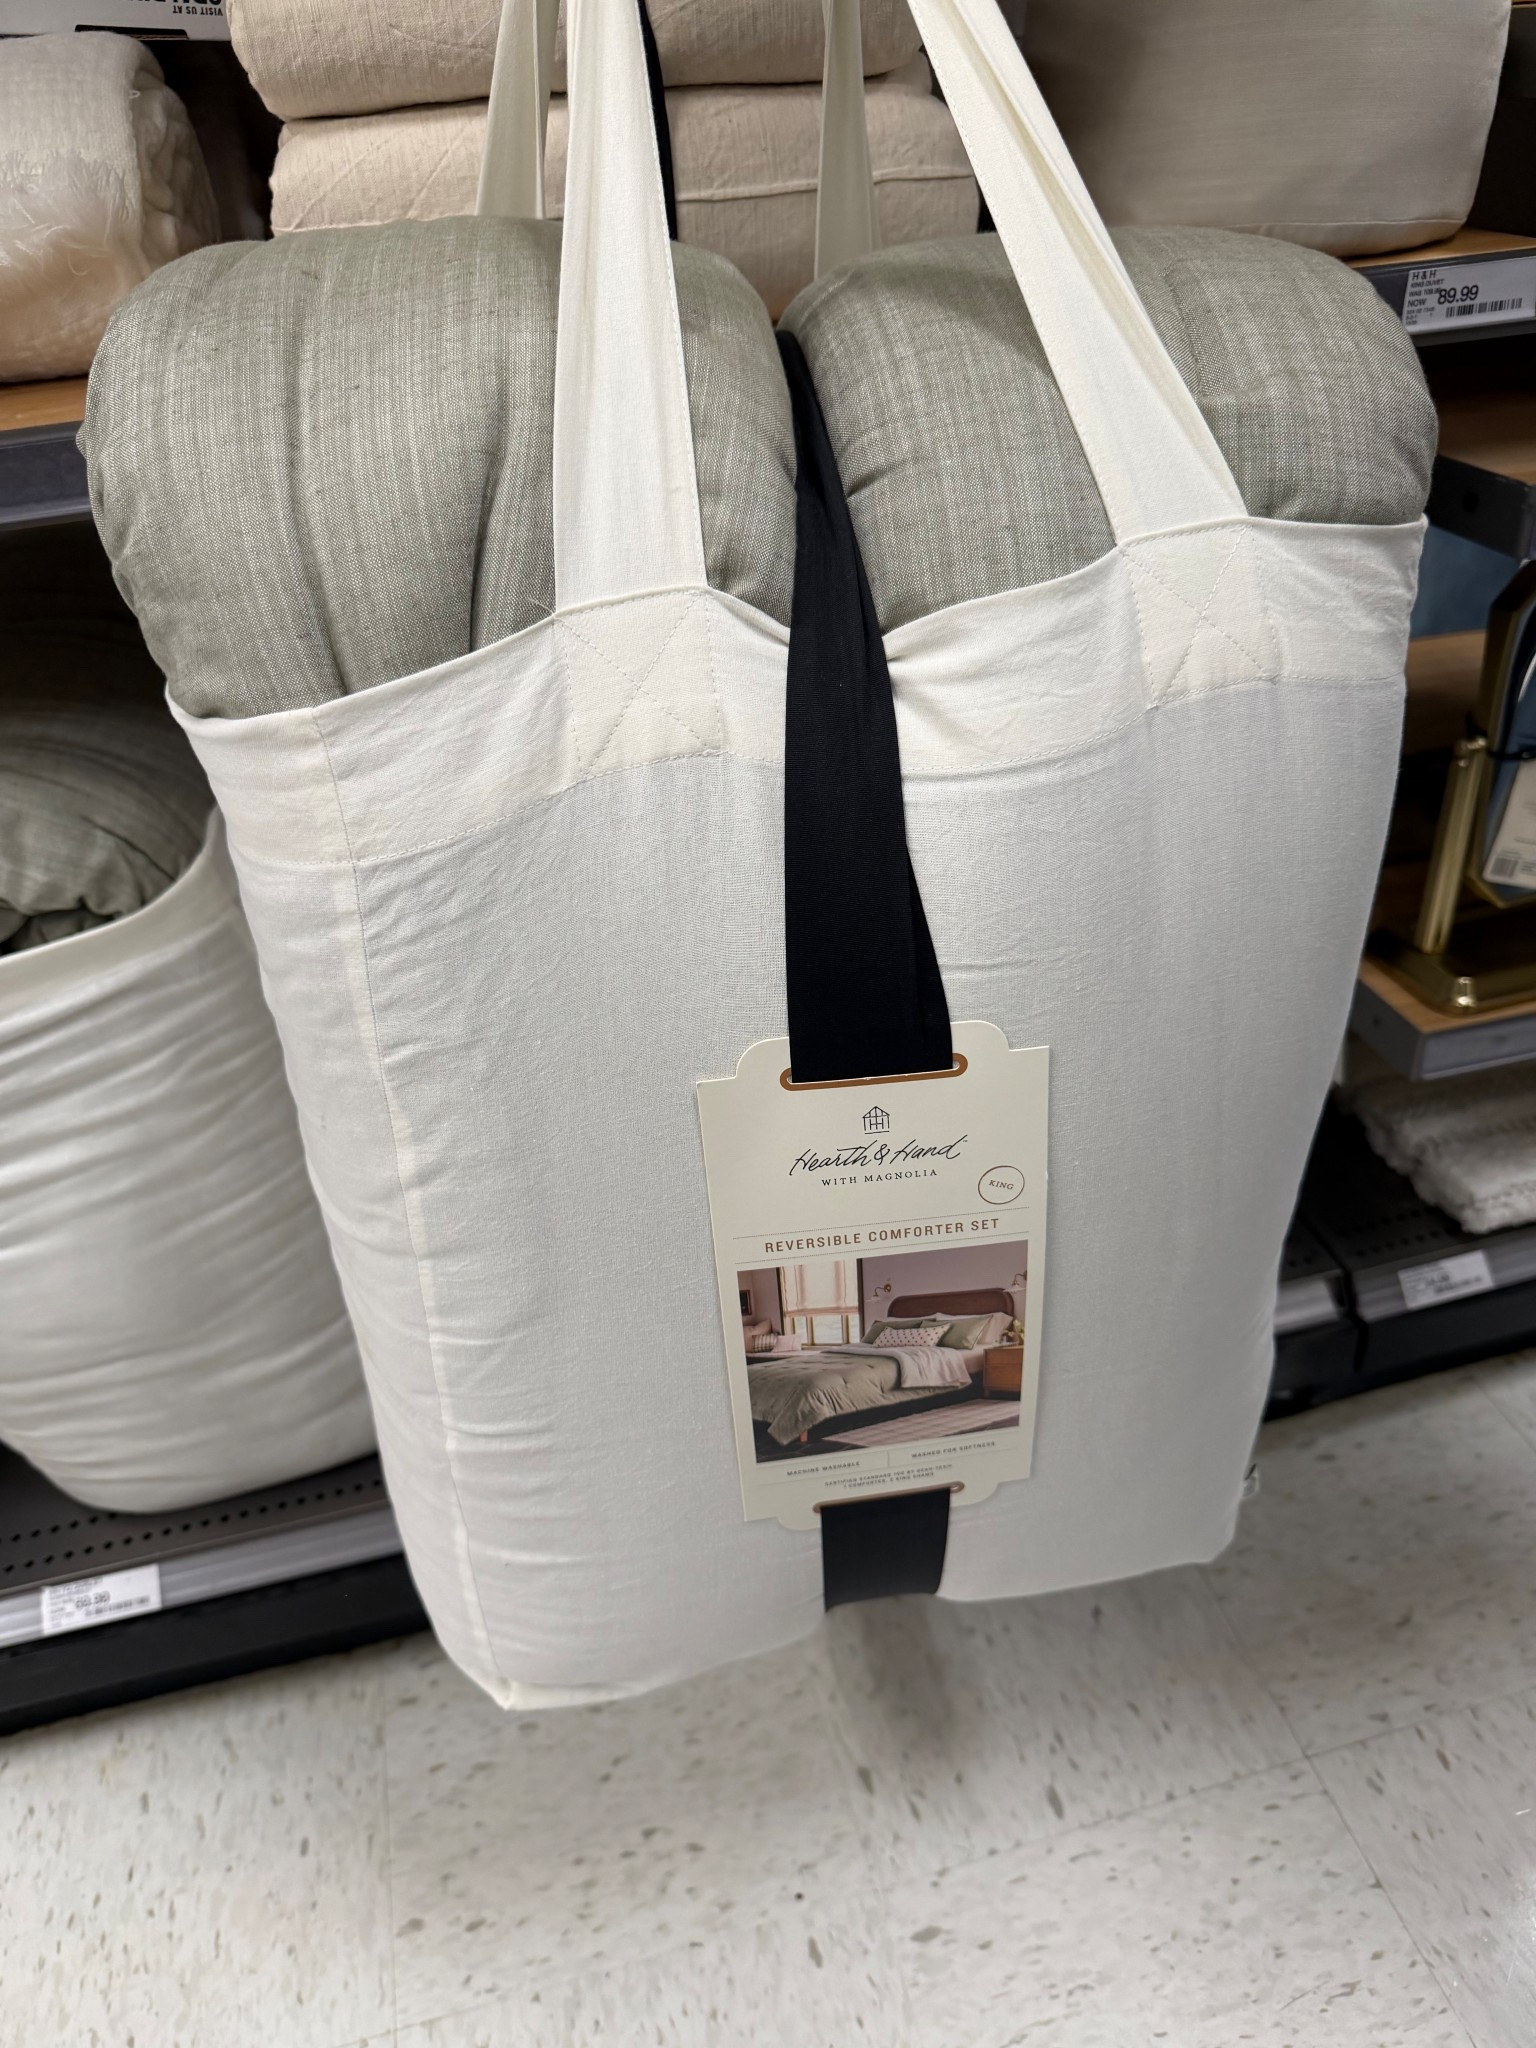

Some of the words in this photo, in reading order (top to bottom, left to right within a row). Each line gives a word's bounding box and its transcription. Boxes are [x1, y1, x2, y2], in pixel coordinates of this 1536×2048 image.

[172, 5, 182, 14] AT
[186, 6, 197, 14] US
[200, 7, 223, 16] VISIT
[1412, 271, 1420, 280] H
[1429, 270, 1437, 279] H
[1407, 298, 1427, 308] NOW
[1437, 285, 1479, 304] 89.99
[788, 1140, 878, 1176] Hearth
[873, 1143, 890, 1165] &
[821, 1176, 857, 1187] WITH
[864, 1169, 937, 1183] MAGNOLIA
[988, 1179, 1014, 1190] KING
[765, 1233, 862, 1253] REVERSIBLE
[868, 1222, 964, 1242] COMFORTER
[971, 1218, 1000, 1231] SET
[911, 1449, 941, 1458] WASHED
[943, 1446, 957, 1454] FOR
[959, 1441, 996, 1451] SOFTNESS
[786, 1467, 820, 1476] MACHINE
[821, 1461, 861, 1471] WASHABLE
